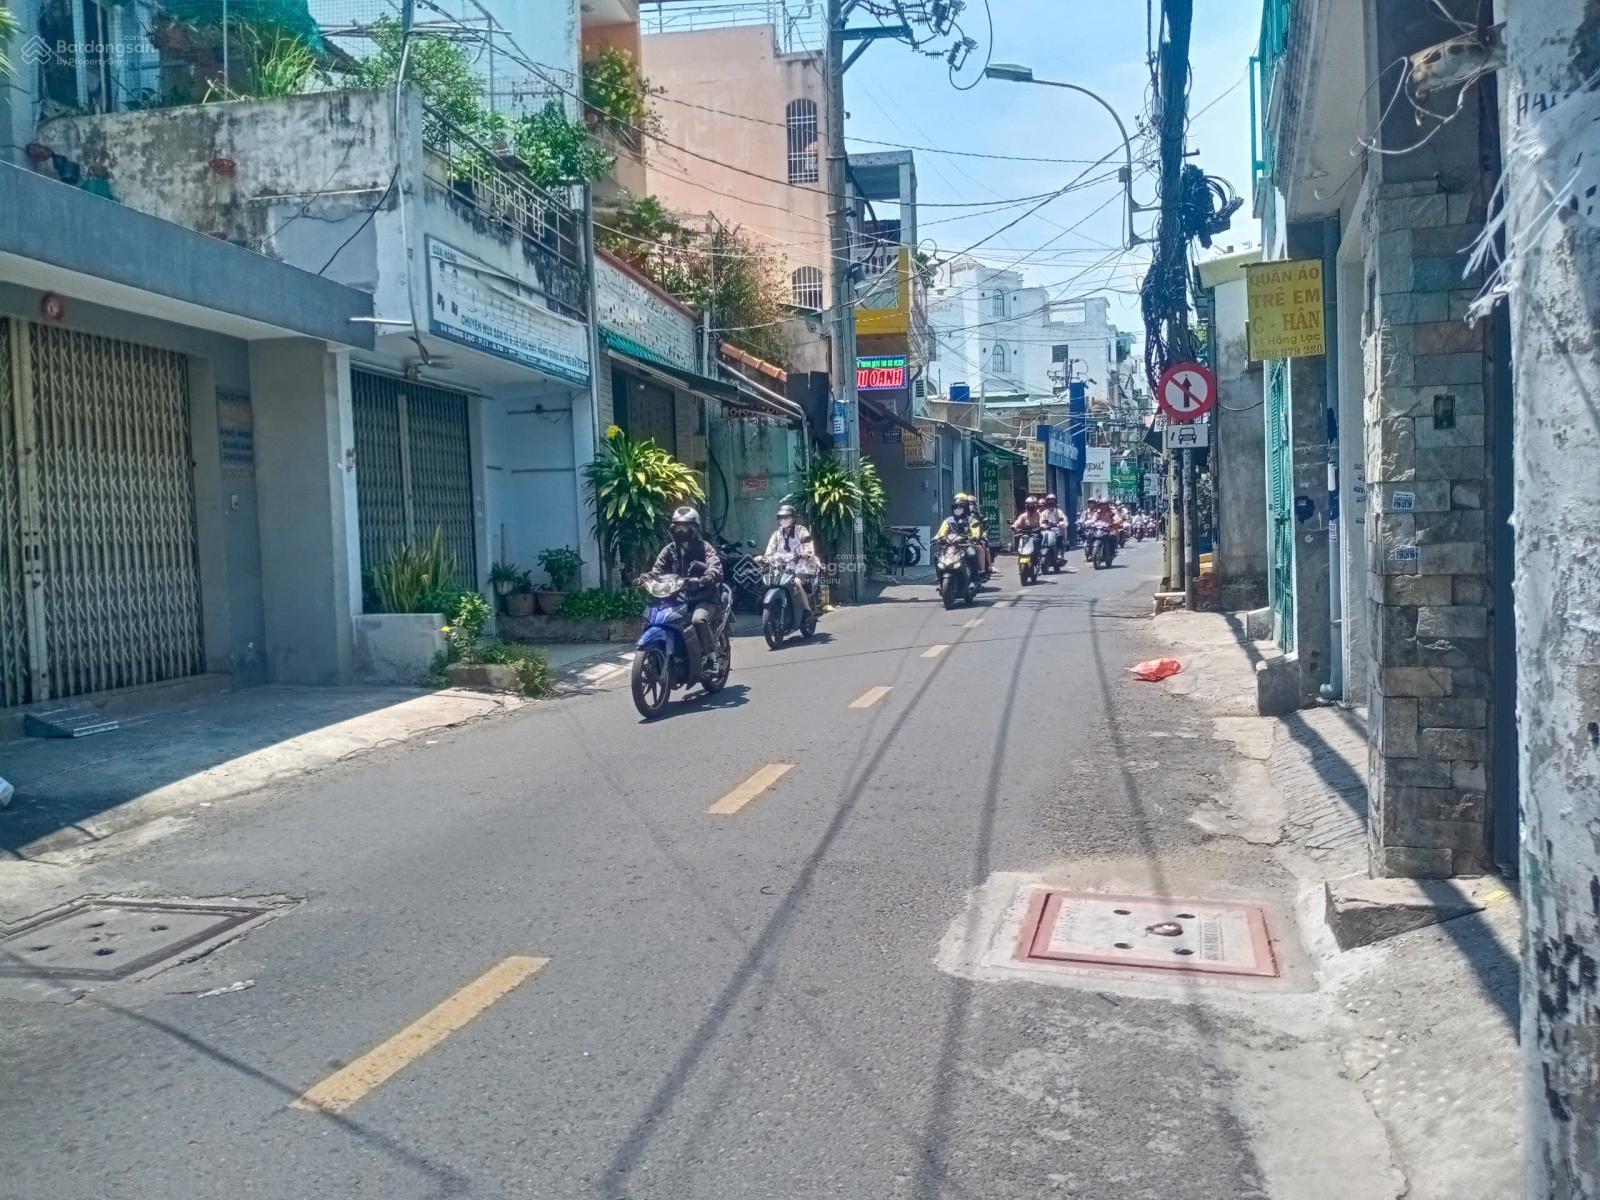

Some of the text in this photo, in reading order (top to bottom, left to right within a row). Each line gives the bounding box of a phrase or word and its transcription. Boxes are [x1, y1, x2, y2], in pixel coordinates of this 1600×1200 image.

[1249, 265, 1319, 287] QUẦN ÁO
[1251, 287, 1320, 308] TRẺ EM
[1282, 306, 1320, 331] HÂN
[870, 368, 903, 386] OANH
